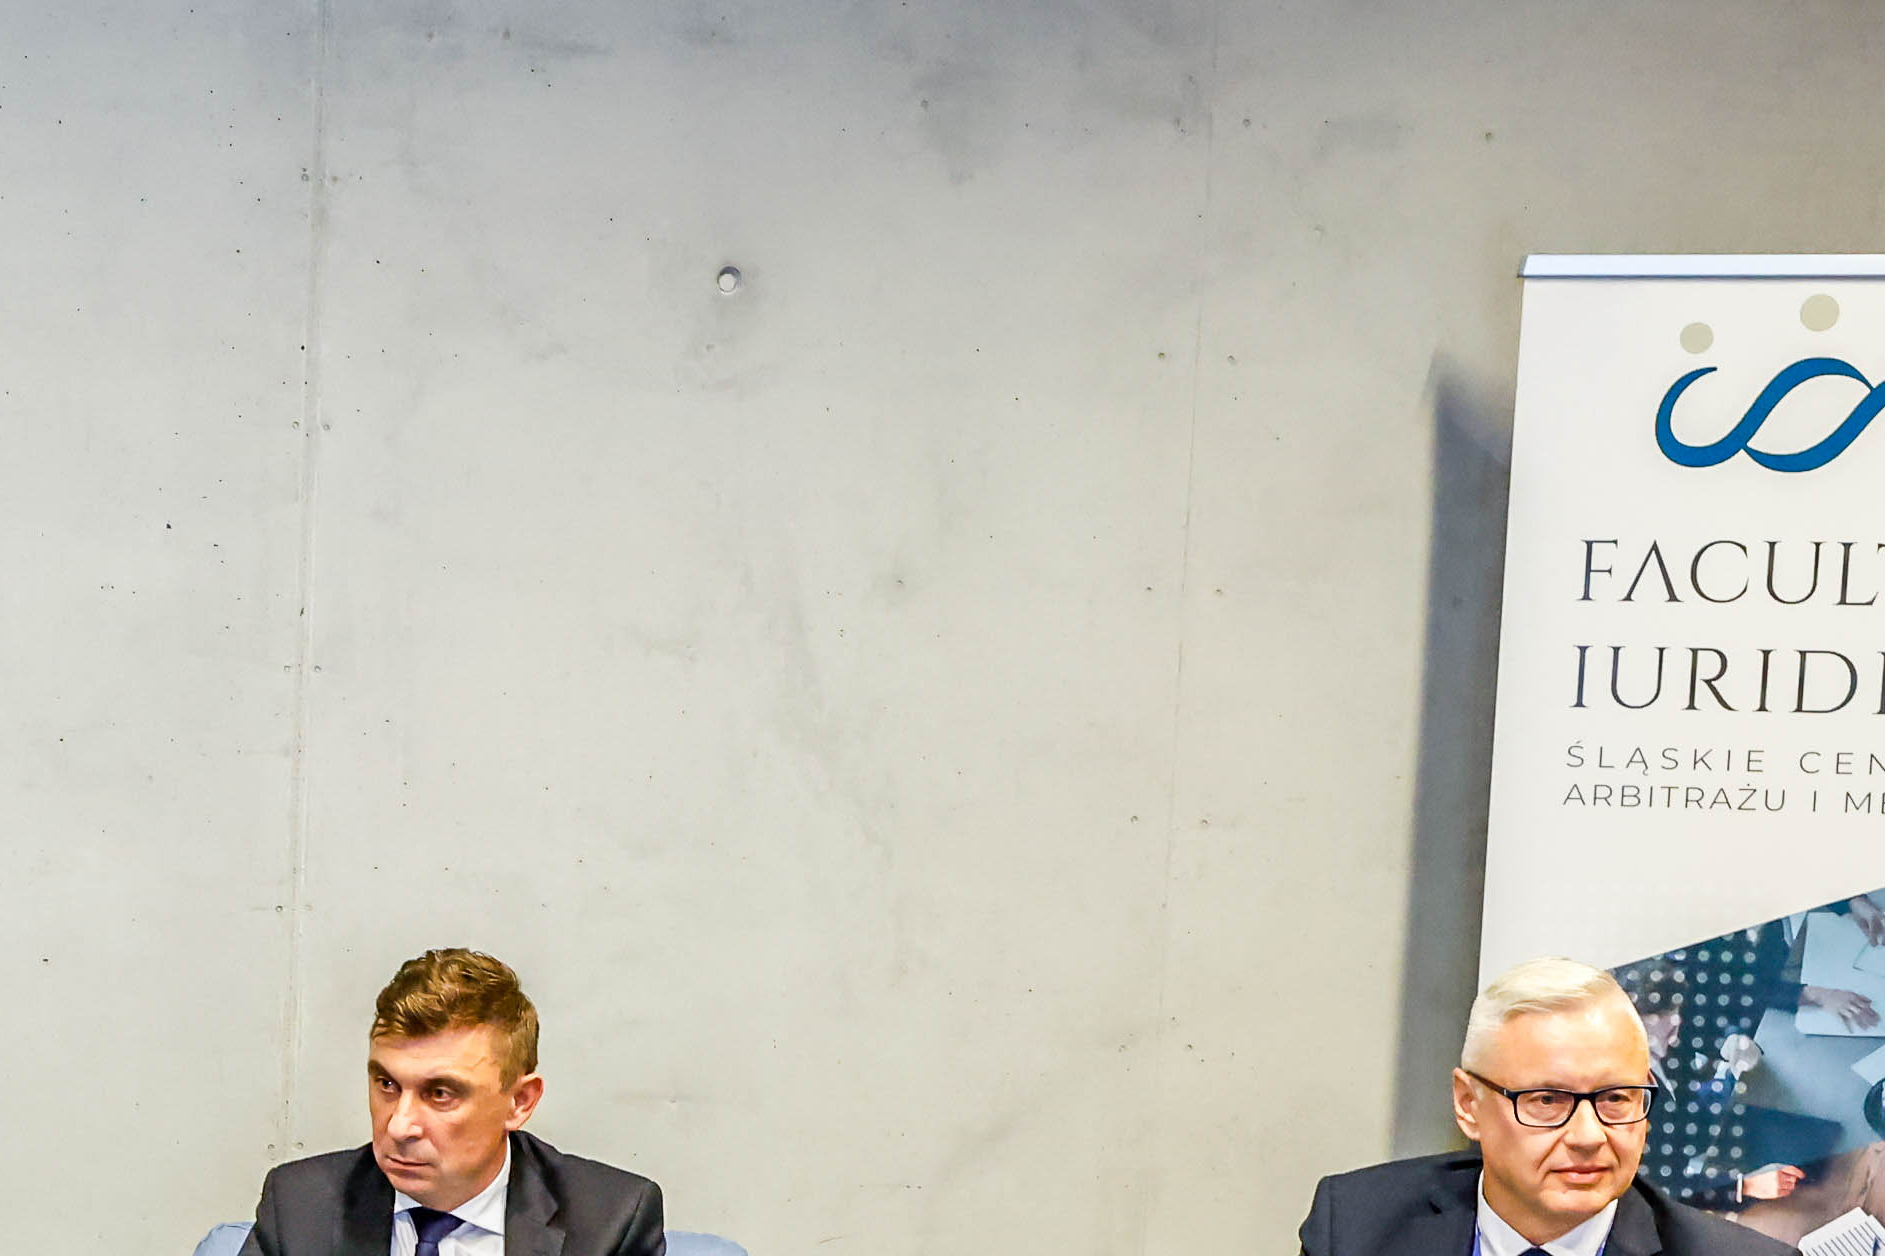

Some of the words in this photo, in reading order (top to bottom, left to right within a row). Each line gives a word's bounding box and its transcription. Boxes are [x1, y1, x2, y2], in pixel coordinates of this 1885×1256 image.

[1577, 539, 1885, 606] FACUL
[1566, 740, 1765, 776] ŚLĄSKIE
[1562, 783, 1786, 812] ARBITRAŻU
[1812, 789, 1817, 813] I
